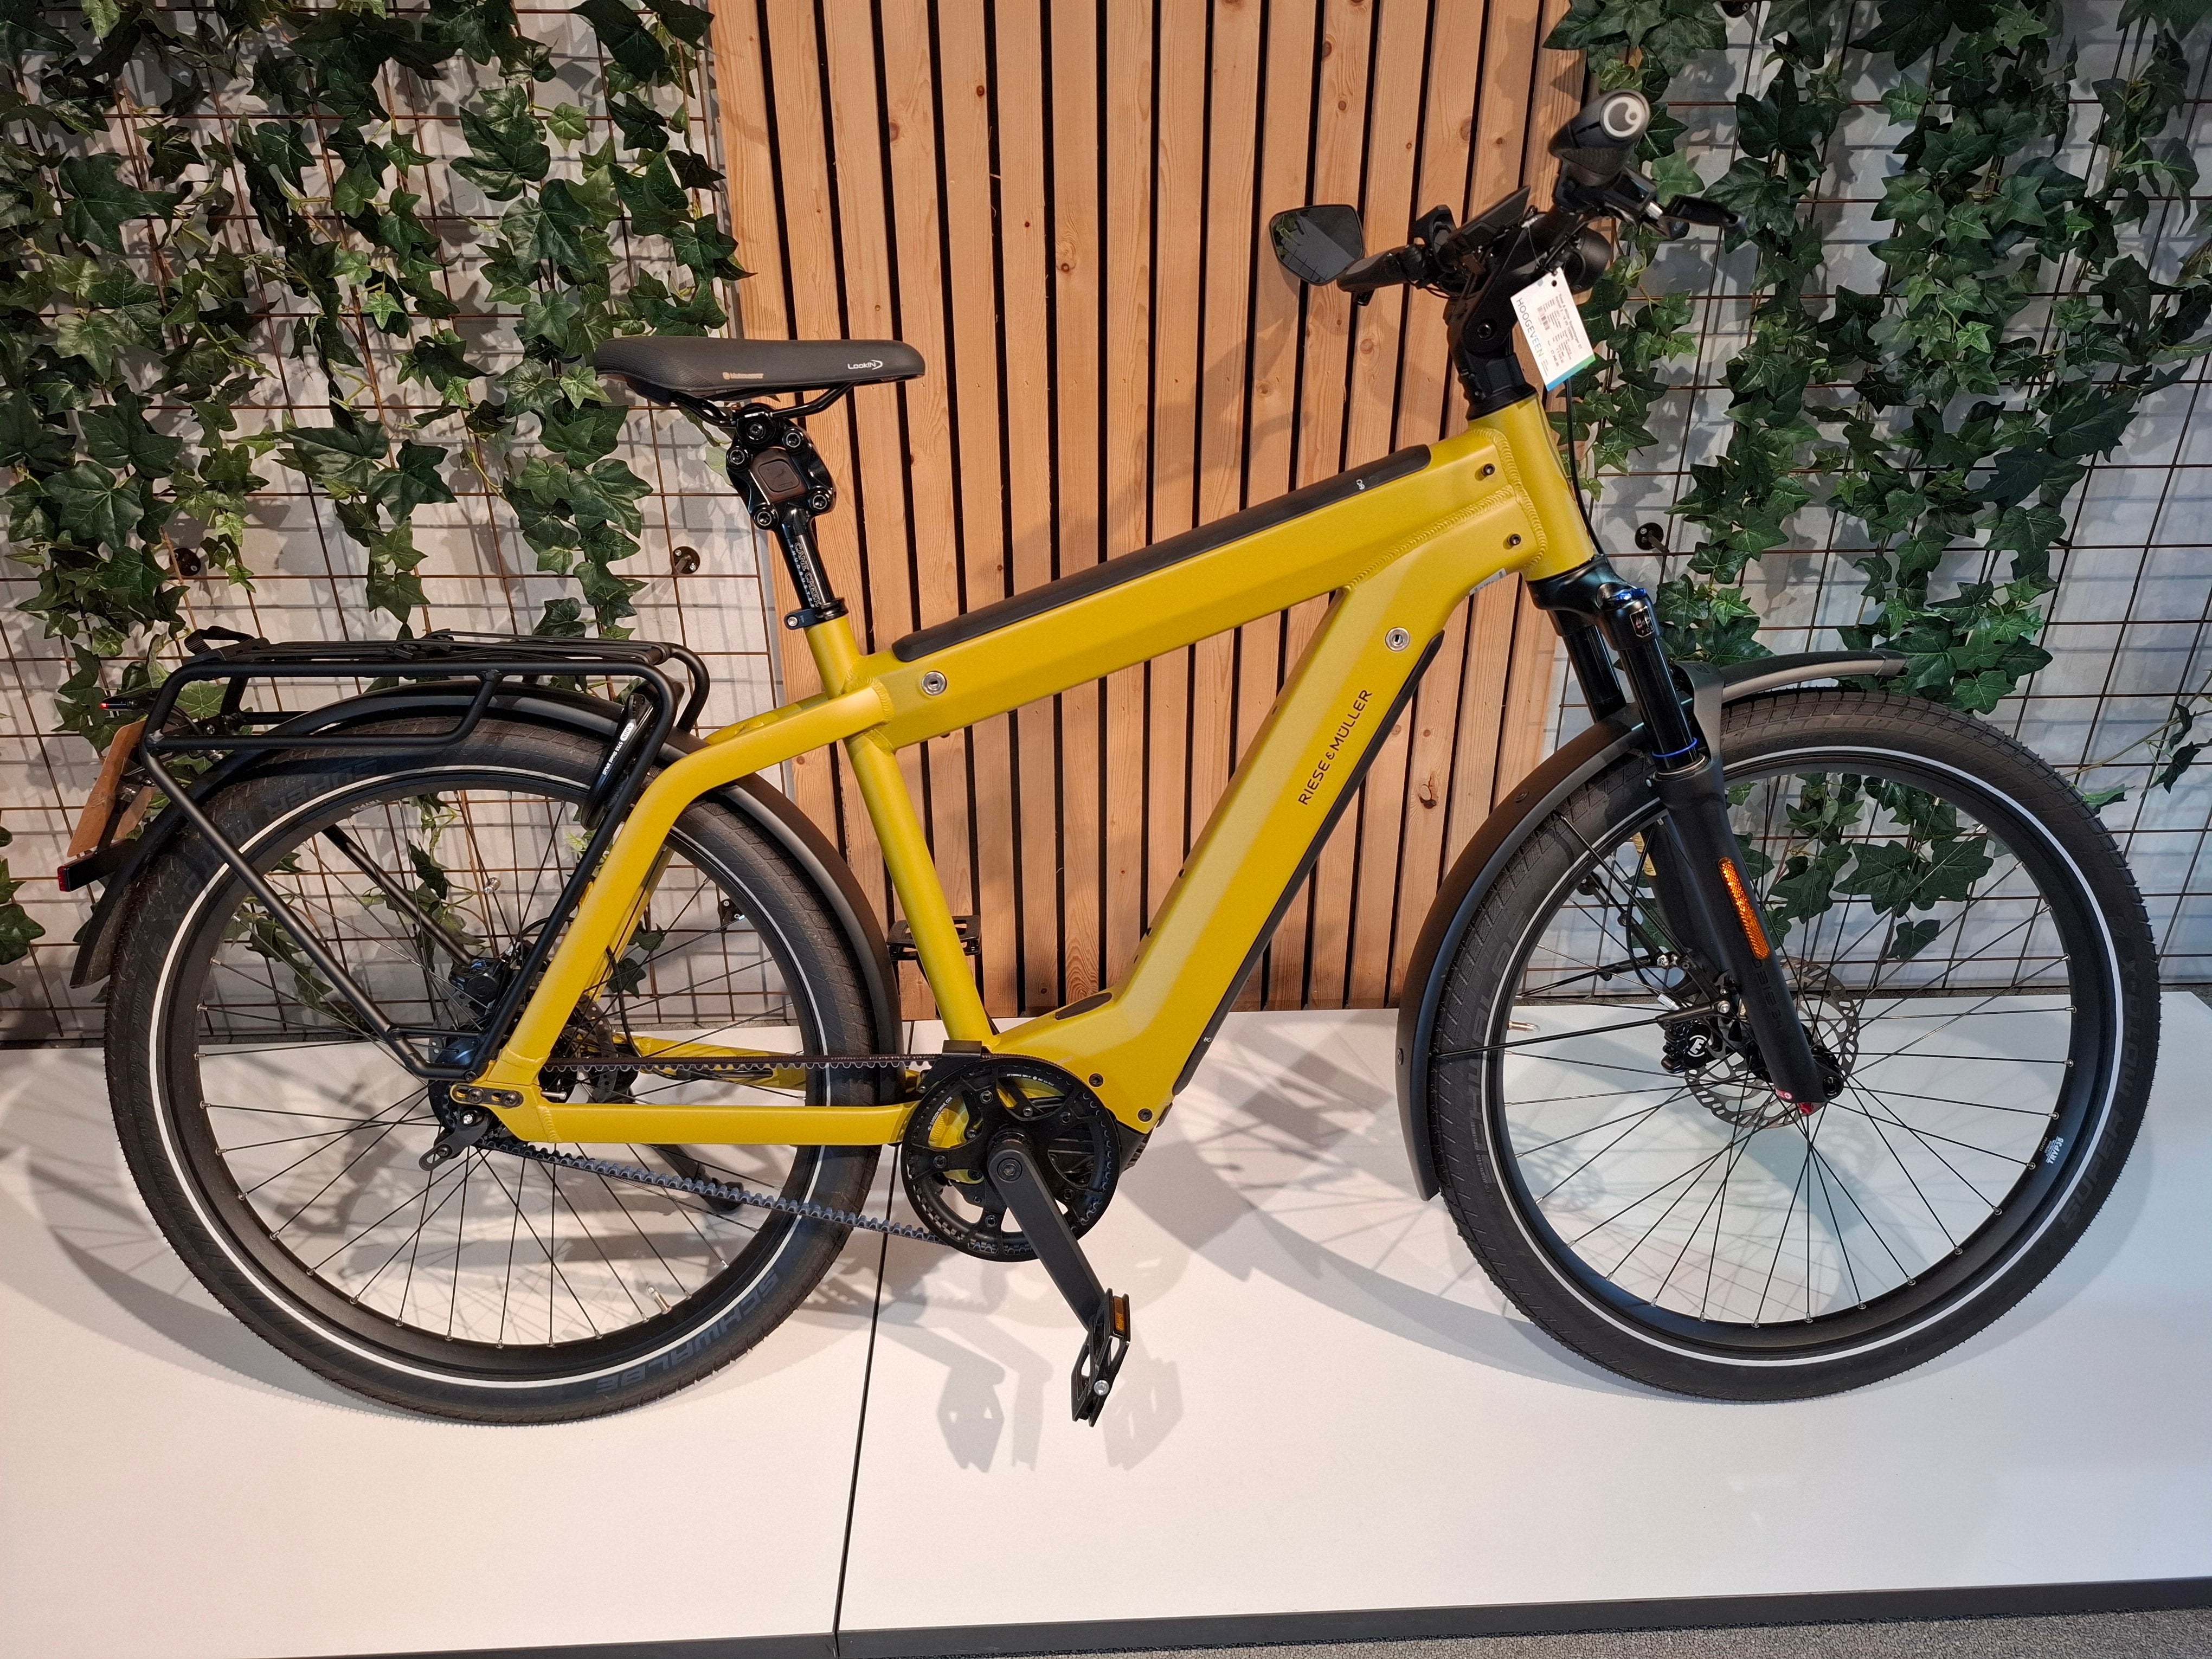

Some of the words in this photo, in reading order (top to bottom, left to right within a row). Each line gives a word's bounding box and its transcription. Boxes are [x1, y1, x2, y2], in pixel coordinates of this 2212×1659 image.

[1516, 297, 1545, 357] HOOGEVEEN
[794, 542, 809, 571] CANE
[805, 571, 822, 607] CREEK
[1329, 689, 1373, 751] MÜLLER
[1298, 760, 1330, 805] RIESE
[1326, 751, 1335, 760] &
[2047, 1137, 2065, 1165] TRYP35
[596, 1269, 779, 1394] SCHWALBE
